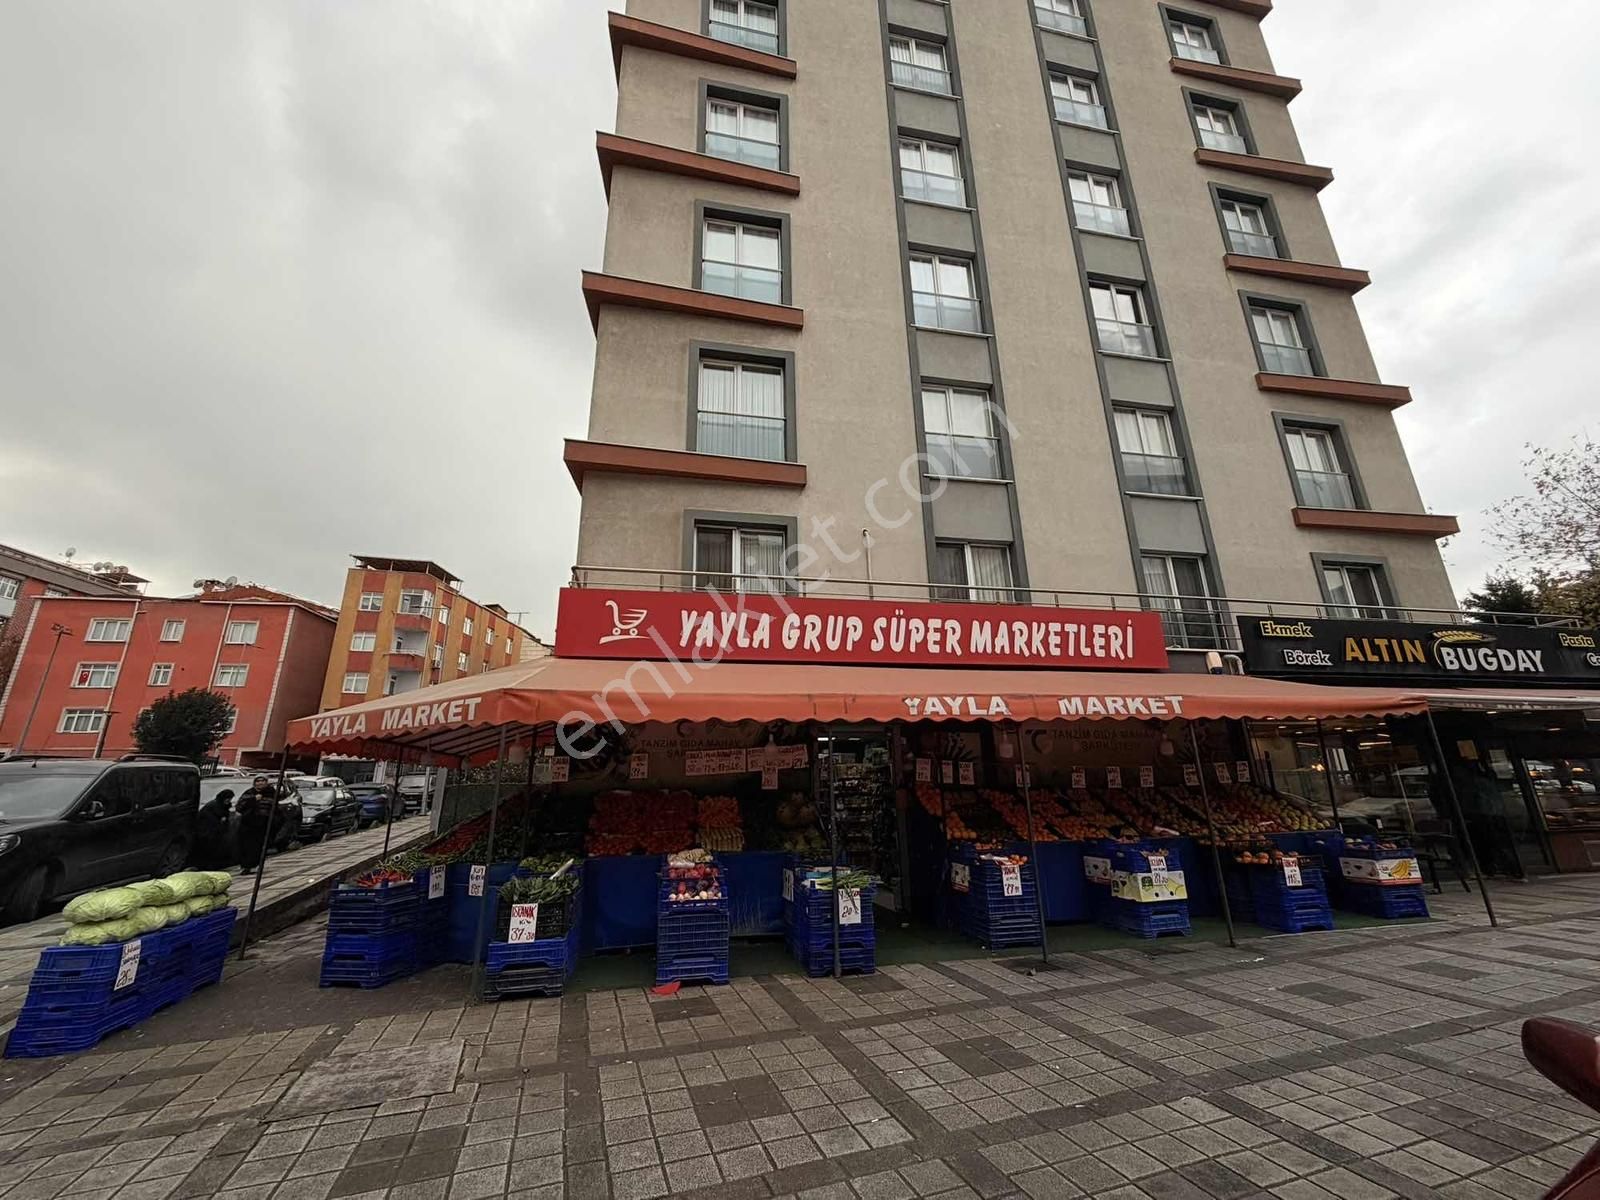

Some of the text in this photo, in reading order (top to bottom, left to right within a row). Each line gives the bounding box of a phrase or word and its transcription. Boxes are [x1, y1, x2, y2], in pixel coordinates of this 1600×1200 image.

[679, 608, 1134, 660] YAYLA GRUP SÜPER MARKETLERİ
[1259, 621, 1314, 638] Ekmek
[1558, 633, 1596, 647] Pasta
[1283, 649, 1333, 666] Börek
[1345, 637, 1426, 663] ALTIN
[904, 695, 1183, 716] YAYLA MARKET
[310, 697, 482, 738] YAYLA MARKET
